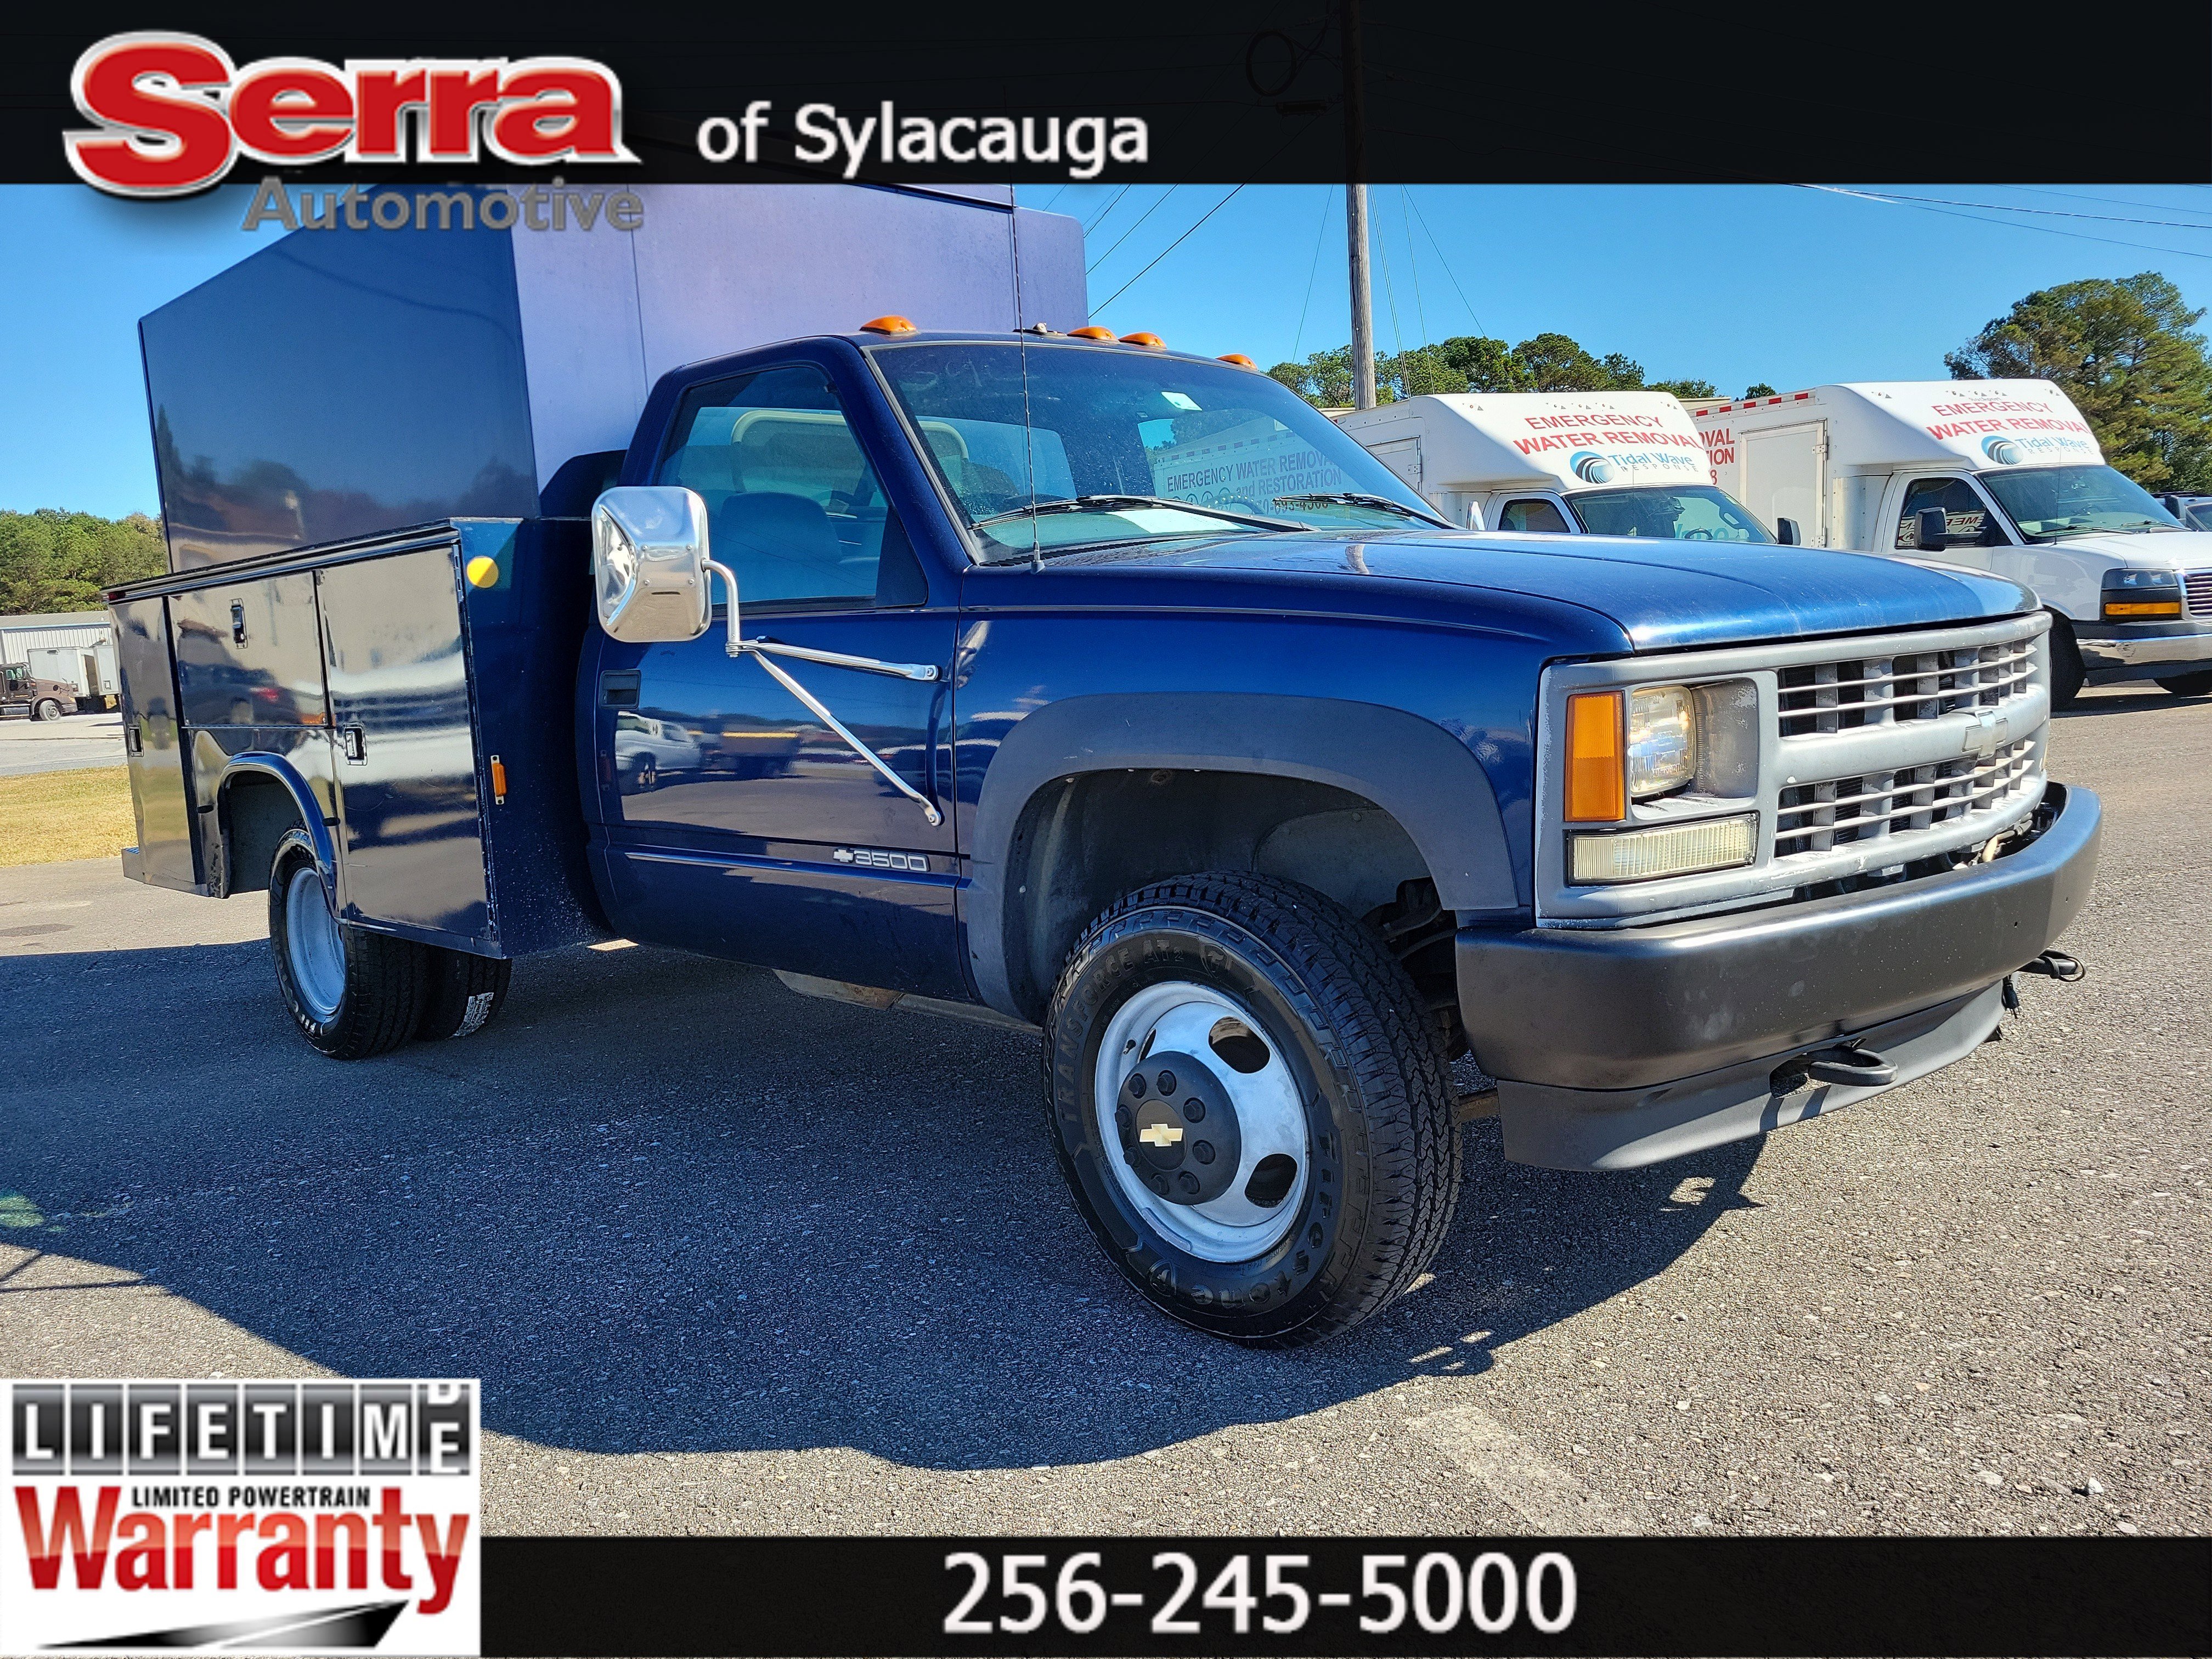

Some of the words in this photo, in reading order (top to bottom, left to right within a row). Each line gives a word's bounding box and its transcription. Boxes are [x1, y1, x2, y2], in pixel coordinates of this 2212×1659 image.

[1931, 402, 2053, 416] EMERGENCY
[1525, 414, 1664, 430] EMERGENCY
[1926, 419, 2009, 440] WATER
[1513, 432, 1605, 455] WATER
[1601, 432, 1705, 452] REMOVAL
[2015, 437, 2055, 449] Tidal
[2051, 437, 2090, 449] Wave
[1607, 453, 1651, 466] Tidal
[1649, 452, 1695, 466] Wave
[1620, 464, 1699, 472] RESPONSE
[1167, 465, 1233, 493] EMERGENCY
[1236, 458, 1274, 480] WATER
[1279, 450, 1335, 473] REMOVA
[1235, 480, 1256, 498] and
[1259, 468, 1342, 495] RESTORATION
[854, 850, 927, 872] 3500
